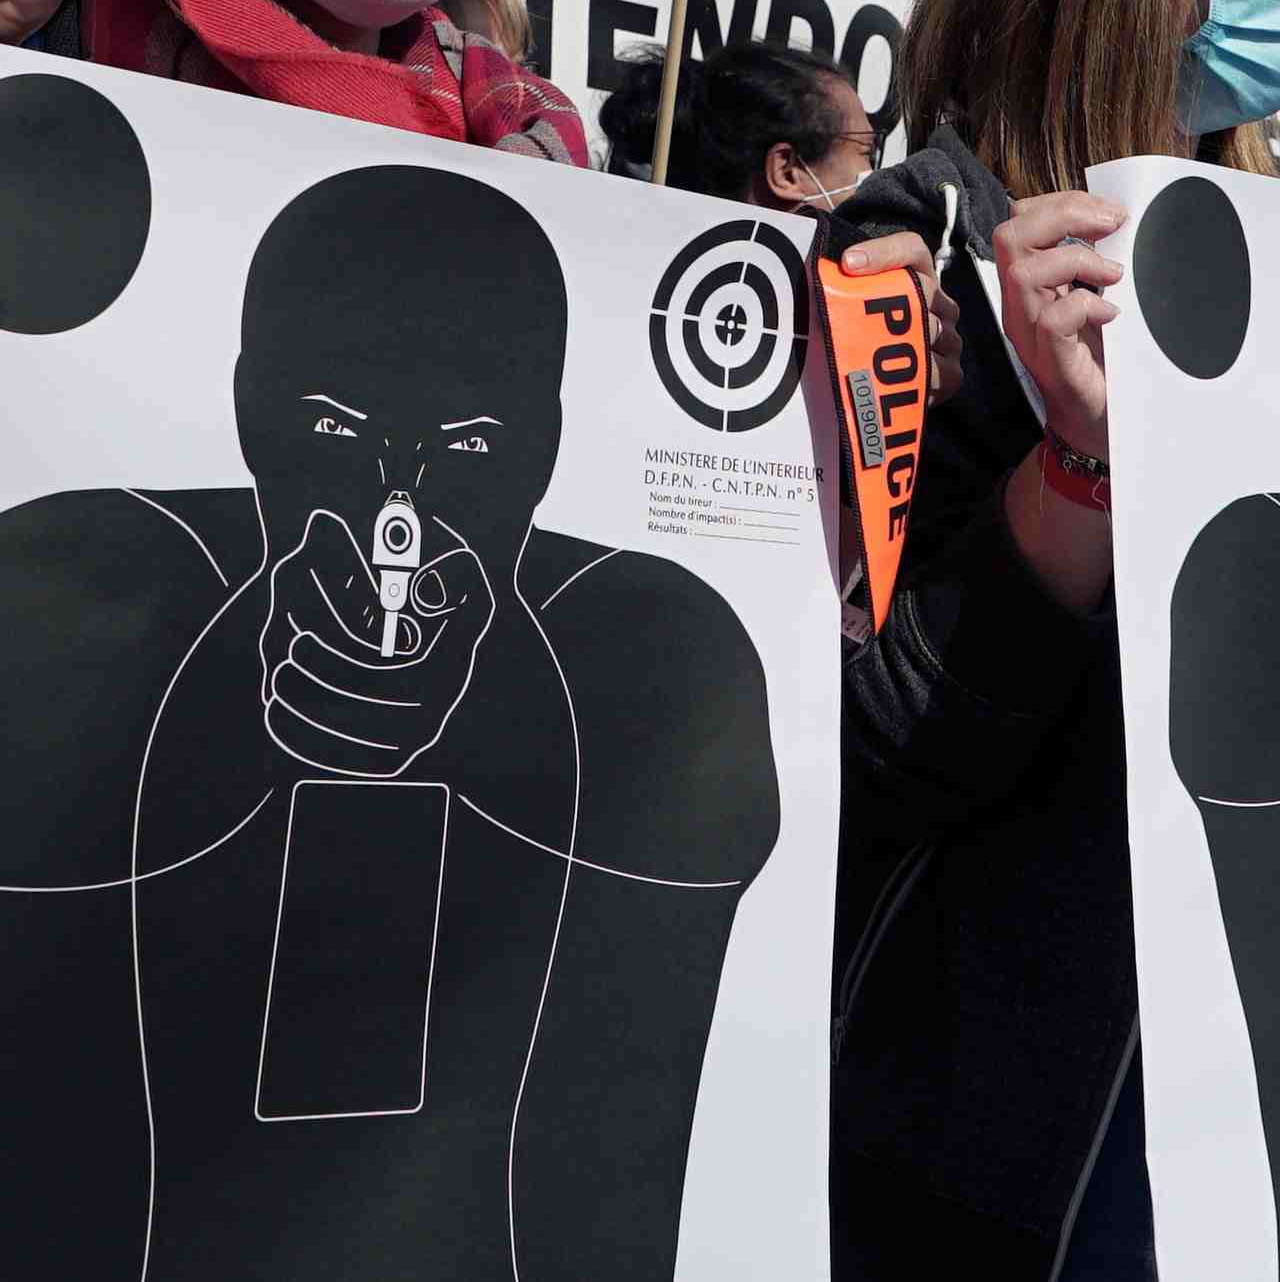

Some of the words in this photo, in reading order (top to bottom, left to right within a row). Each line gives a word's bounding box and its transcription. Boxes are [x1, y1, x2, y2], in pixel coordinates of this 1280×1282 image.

[863, 293, 919, 542] POLICE
[645, 448, 717, 470] MINISTERE
[722, 457, 739, 473] DE
[649, 491, 671, 502] Nom
